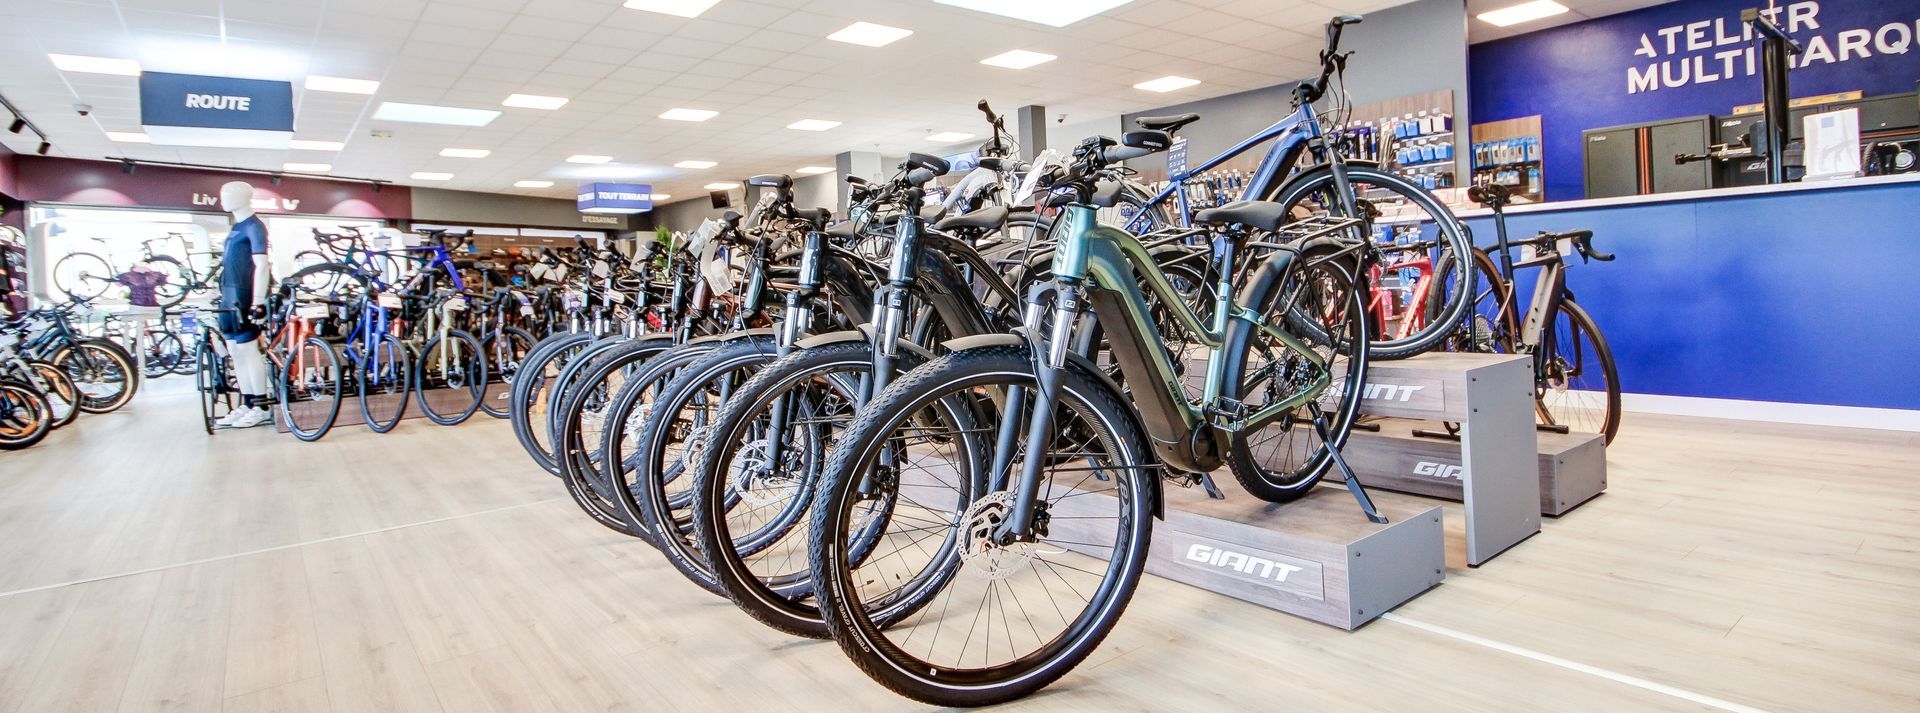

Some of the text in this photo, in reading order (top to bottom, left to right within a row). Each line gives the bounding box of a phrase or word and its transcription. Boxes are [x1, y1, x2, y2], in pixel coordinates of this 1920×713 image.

[1627, 18, 1920, 94] MULTIARQ
[185, 93, 251, 111] ROUTE
[193, 193, 218, 206] Liv
[597, 191, 619, 200] TOUT
[619, 192, 650, 201] TERRAIN
[1056, 208, 1075, 268] GIANT
[1412, 461, 1464, 481] GIA
[1186, 543, 1304, 583] GIANT
